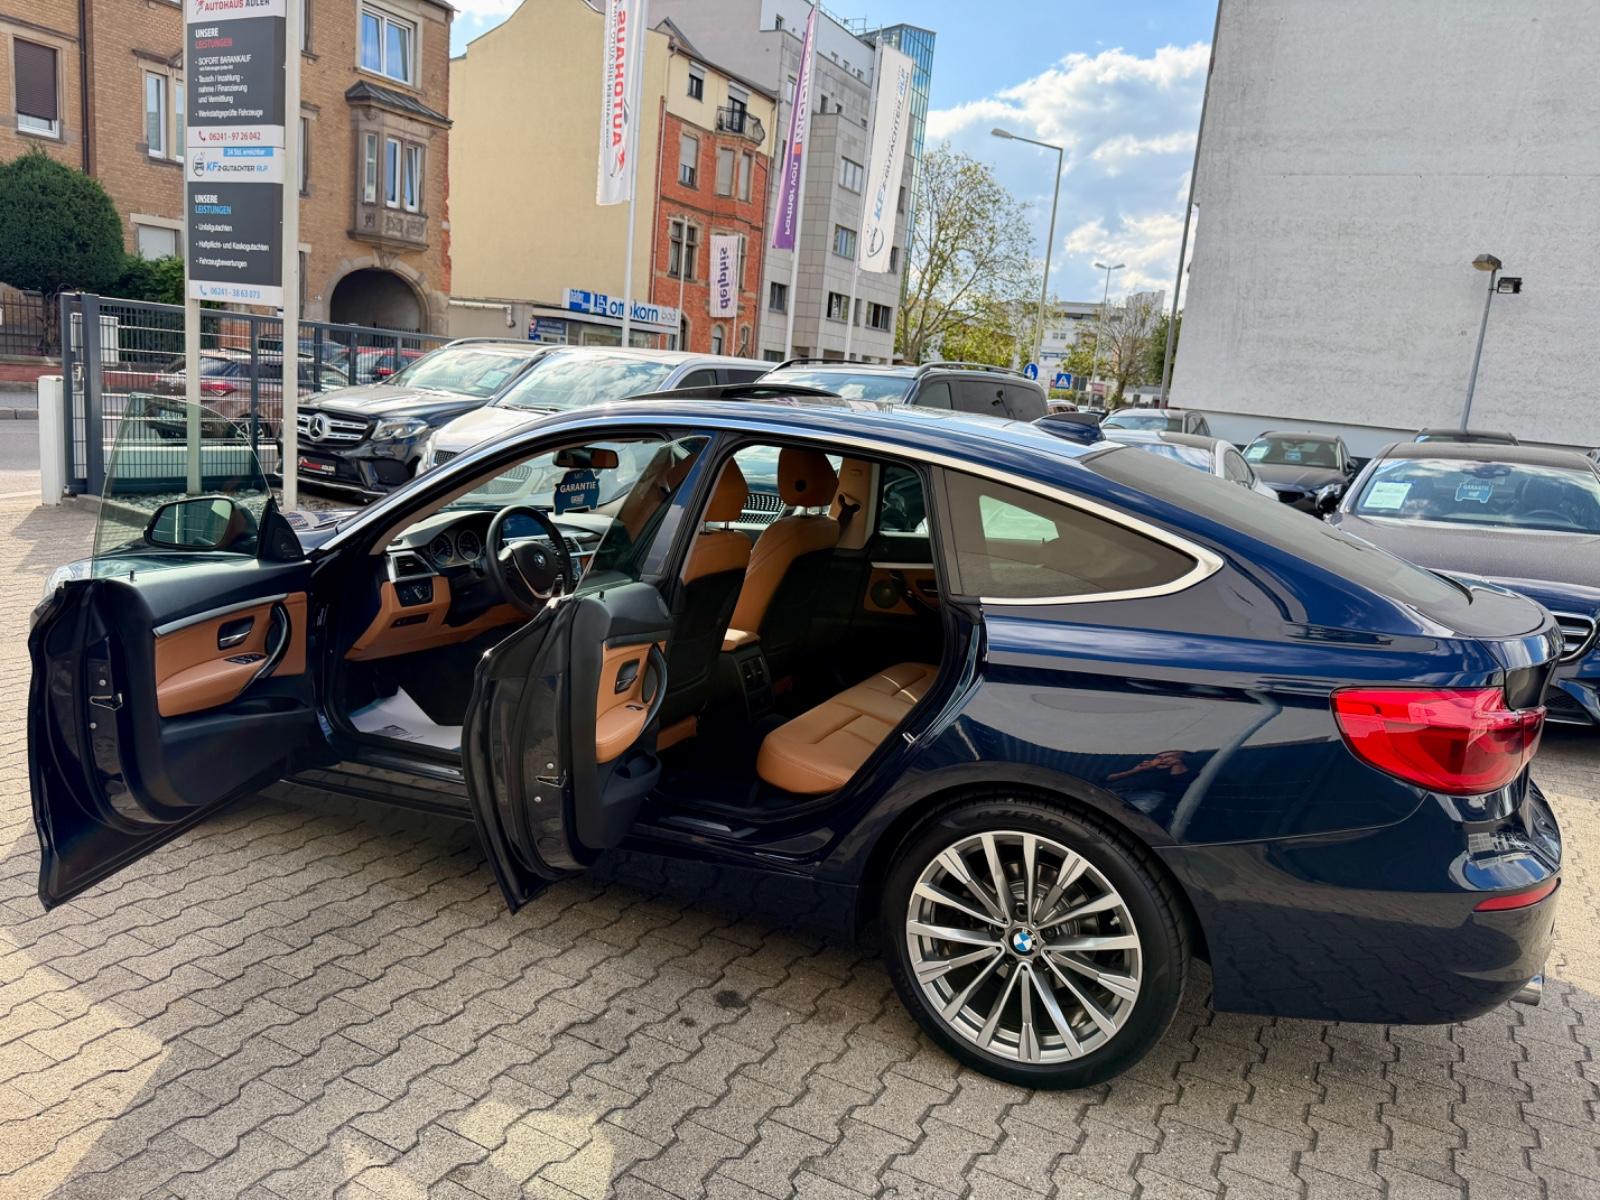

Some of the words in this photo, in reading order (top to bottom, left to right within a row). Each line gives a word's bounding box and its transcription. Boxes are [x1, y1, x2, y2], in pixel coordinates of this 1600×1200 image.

[205, 0, 244, 11] AUTOHAUS
[195, 28, 219, 38] UNSERE
[198, 56, 220, 66] SOFORT
[220, 54, 252, 63] BARANKAUF
[195, 195, 218, 204] UNSERE
[195, 205, 232, 215] LEISTUNGEN
[610, 300, 659, 321] ottkorn
[560, 481, 597, 493] GARANTIE
